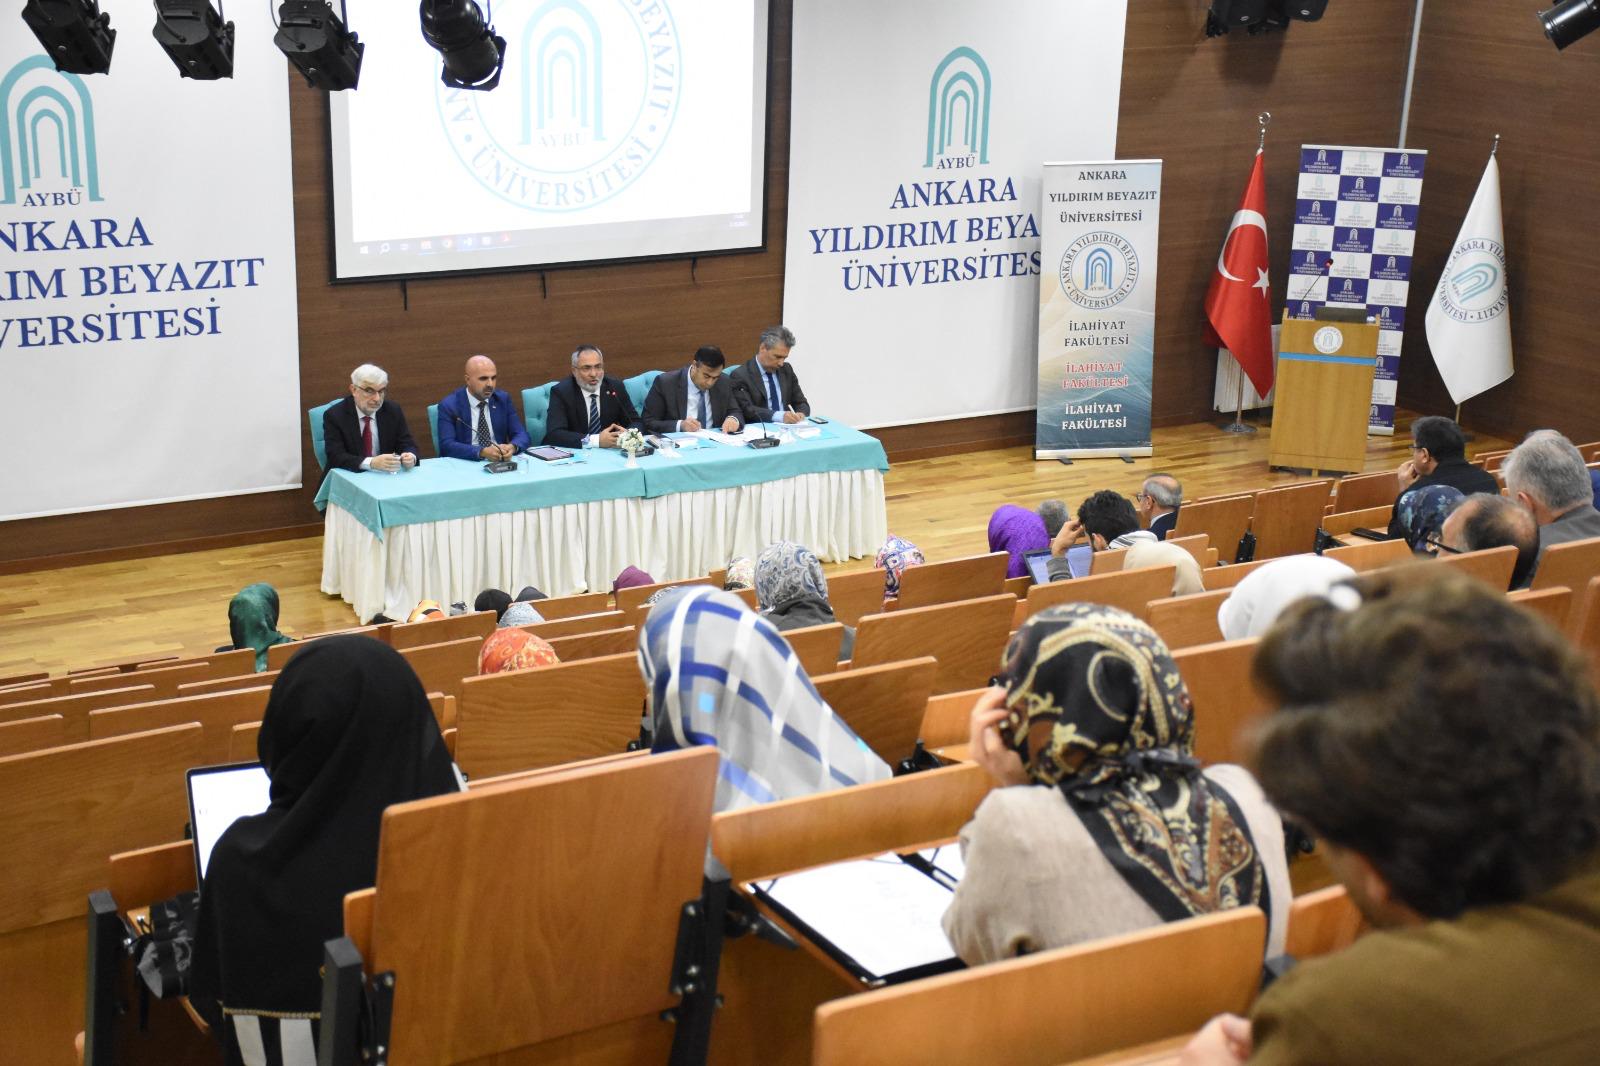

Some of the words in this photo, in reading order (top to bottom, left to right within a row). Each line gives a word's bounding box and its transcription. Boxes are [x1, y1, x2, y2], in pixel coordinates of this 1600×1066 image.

[630, 0, 675, 117] EYAZIT
[936, 153, 976, 170] AYBÜ
[1078, 170, 1127, 181] ANKARA
[23, 188, 82, 208] AYBÜ
[889, 176, 1018, 210] ANKARA
[1049, 192, 1103, 203] YILDIRIM
[1107, 190, 1157, 201] BEYAZIT
[1060, 209, 1143, 223] ÜNİVERSİTESİ
[808, 218, 958, 255] YILDIRIM
[964, 212, 1041, 243] BEYA
[0, 268, 68, 301] IM
[80, 257, 265, 297] BEYAZIT
[1069, 319, 1126, 331] İLAHİYAT
[1064, 334, 1129, 347] FAKÜLTESİ
[1066, 361, 1124, 373] İLAHİYAT
[1062, 374, 1129, 389] FAKÜLTESİ
[1065, 402, 1122, 415] İLAHİYAT
[1062, 416, 1127, 430] FAKÜLTESİ
